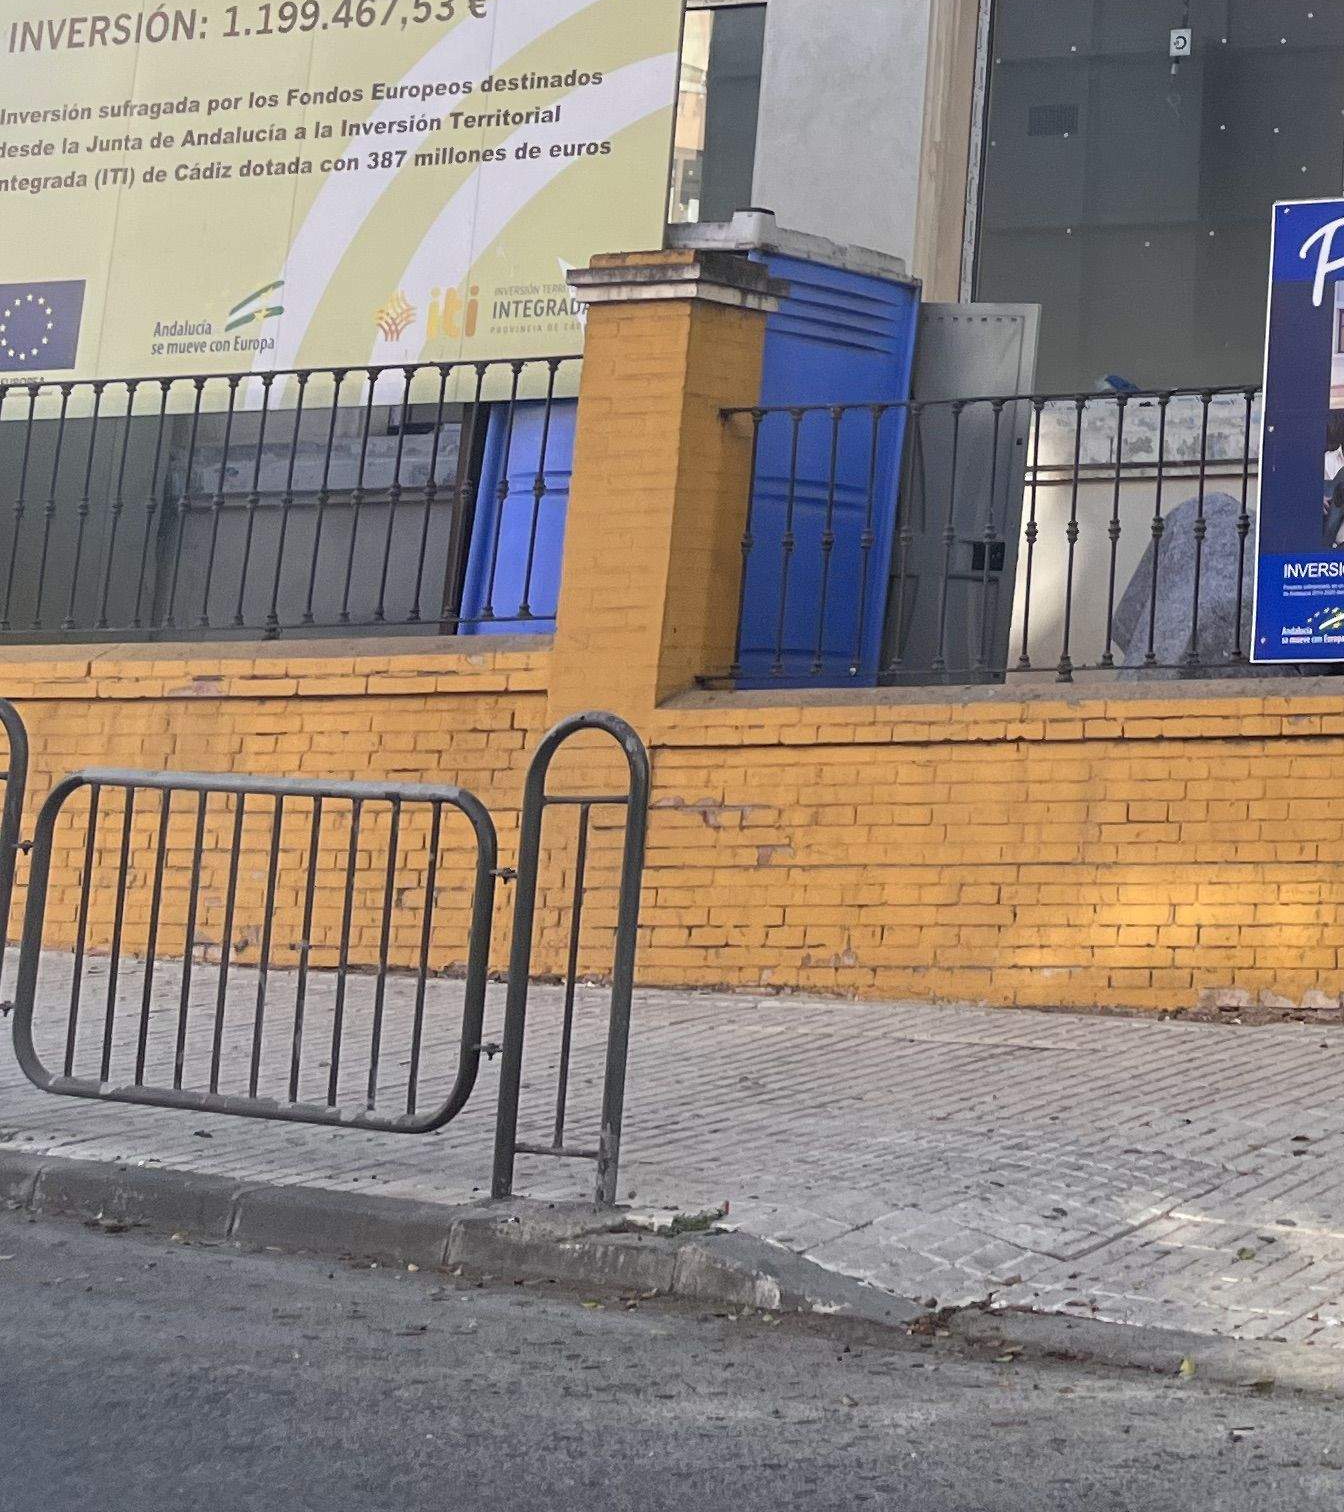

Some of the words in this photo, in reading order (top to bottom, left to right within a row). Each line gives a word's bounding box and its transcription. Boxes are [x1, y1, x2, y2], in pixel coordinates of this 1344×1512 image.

[8, 3, 209, 54] INVERSIÓN:
[0, 104, 92, 125] Inversión
[99, 96, 200, 120] sufragada
[207, 95, 243, 116] por
[249, 91, 279, 109] los
[287, 86, 363, 106] Fondos
[371, 82, 473, 102] Europeos
[480, 69, 603, 94] destinados
[61, 138, 79, 155] la
[86, 135, 143, 153] Junta
[150, 131, 175, 149] de
[181, 123, 287, 148] Andalucía
[294, 126, 306, 140] a
[314, 121, 333, 139] la
[341, 113, 442, 137] Inversión
[449, 105, 561, 130] Territorial
[0, 170, 88, 195] ntegrada
[94, 167, 135, 190] (ITI)
[142, 165, 167, 184] de
[174, 161, 232, 182] Cádiz
[239, 156, 313, 179] dotada
[319, 159, 359, 173] con
[367, 150, 407, 171] 387
[414, 147, 507, 168] millones
[514, 142, 542, 160] de
[549, 141, 612, 158] euros
[151, 343, 163, 356] se
[166, 340, 207, 355] mueve
[210, 337, 230, 352] con
[233, 335, 275, 352] Europa
[153, 319, 213, 338] Andalucía
